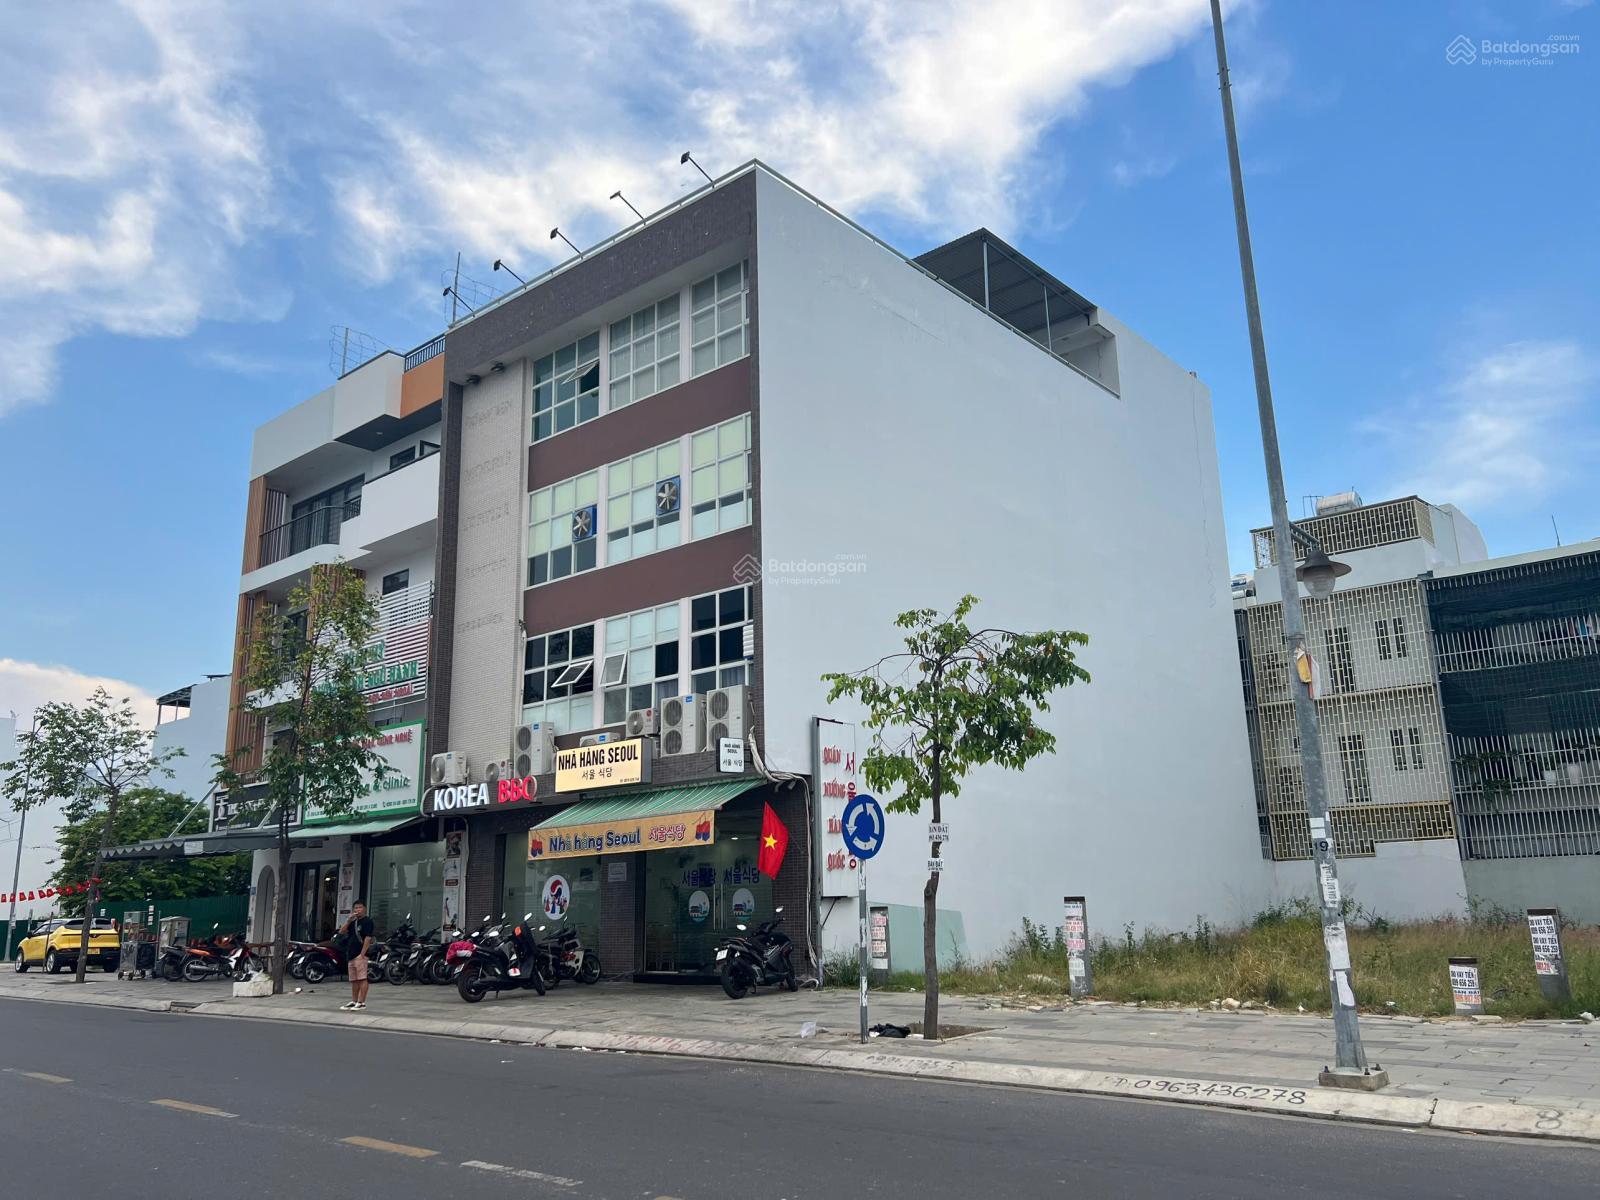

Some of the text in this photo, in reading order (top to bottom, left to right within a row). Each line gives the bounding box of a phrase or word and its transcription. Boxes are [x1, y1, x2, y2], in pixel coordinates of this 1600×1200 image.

[558, 744, 638, 771] NHÀ HÀNG SEOUL
[383, 774, 411, 791] clinic
[582, 767, 613, 780] 서울 식당
[434, 775, 538, 811] KOREA BBQ
[550, 823, 686, 851] Nhà hàng Seoul 서울식당
